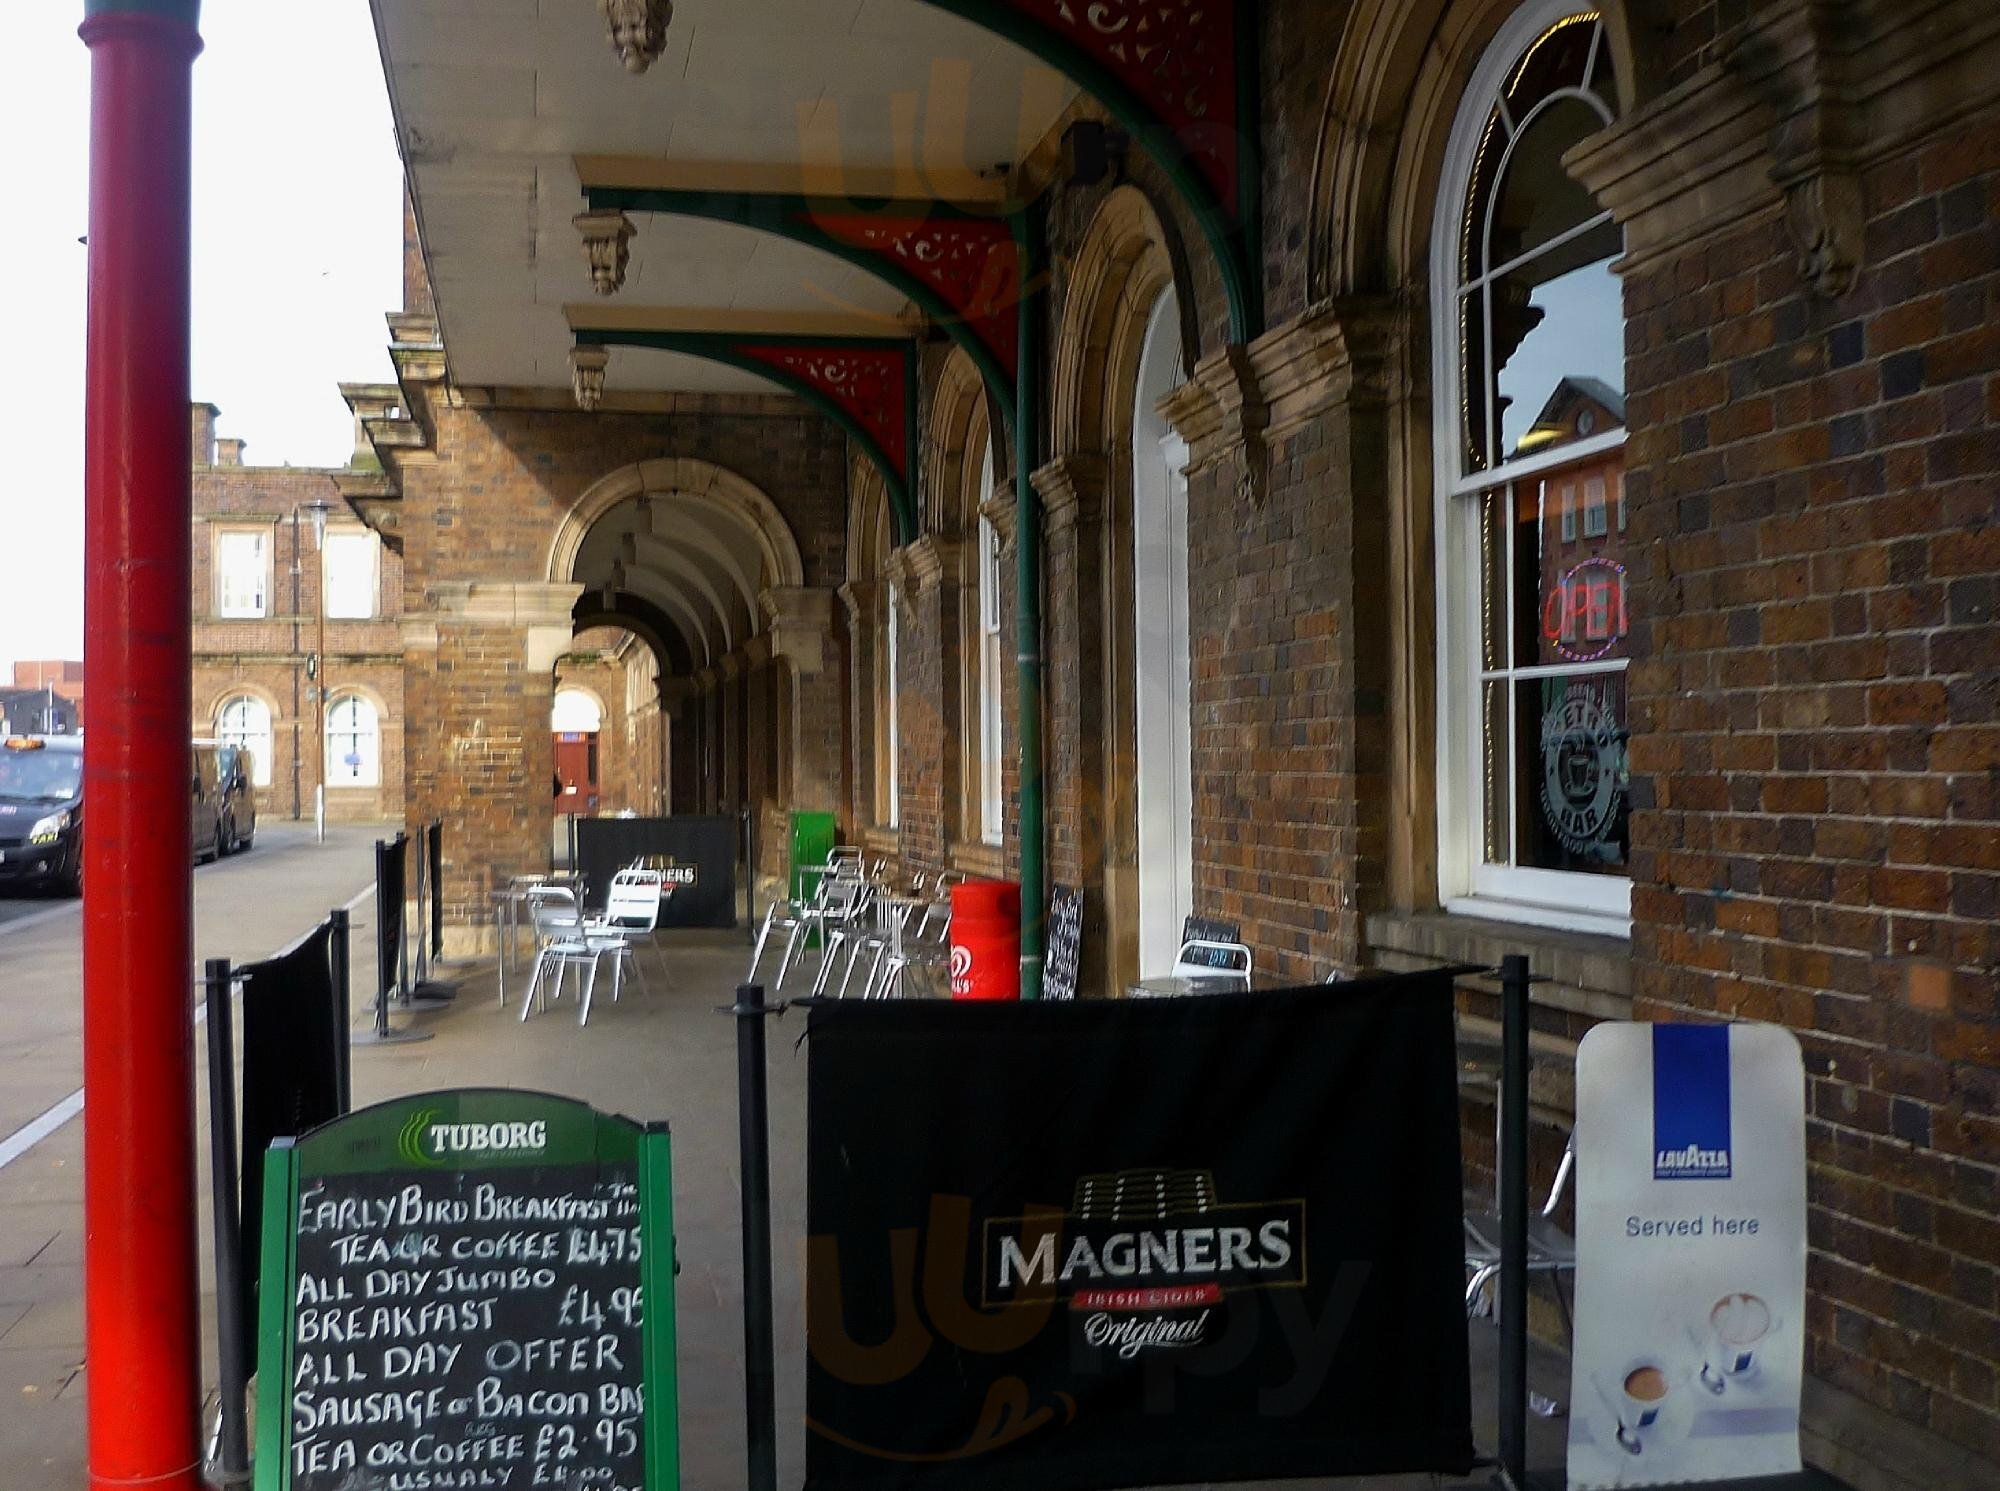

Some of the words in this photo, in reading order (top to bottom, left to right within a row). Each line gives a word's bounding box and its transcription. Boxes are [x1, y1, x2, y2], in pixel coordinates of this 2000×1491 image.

[431, 1120, 547, 1152] TUBORG
[1656, 1143, 1728, 1169] LAVAZZA
[297, 1185, 397, 1235] EARLY
[399, 1184, 469, 1225] BIRD
[474, 1182, 610, 1222] BREAKFAST
[1626, 1215, 1704, 1238] Served
[1712, 1214, 1760, 1236] here
[331, 1233, 392, 1266] TEA
[452, 1231, 560, 1261] COFFEE
[998, 1219, 1292, 1288] MAGNERS
[296, 1271, 354, 1308] ALL
[366, 1269, 433, 1299] DAY
[298, 1297, 498, 1344] BREAKFAST
[1083, 1307, 1211, 1360] Original
[294, 1352, 368, 1389] ALL
[384, 1341, 463, 1380] DAY
[486, 1334, 624, 1373] OFFER
[293, 1384, 446, 1434] SAUSAGE
[291, 1433, 356, 1476] TEA
[409, 1433, 525, 1466] COFFEE
[533, 1416, 638, 1463] £2.95
